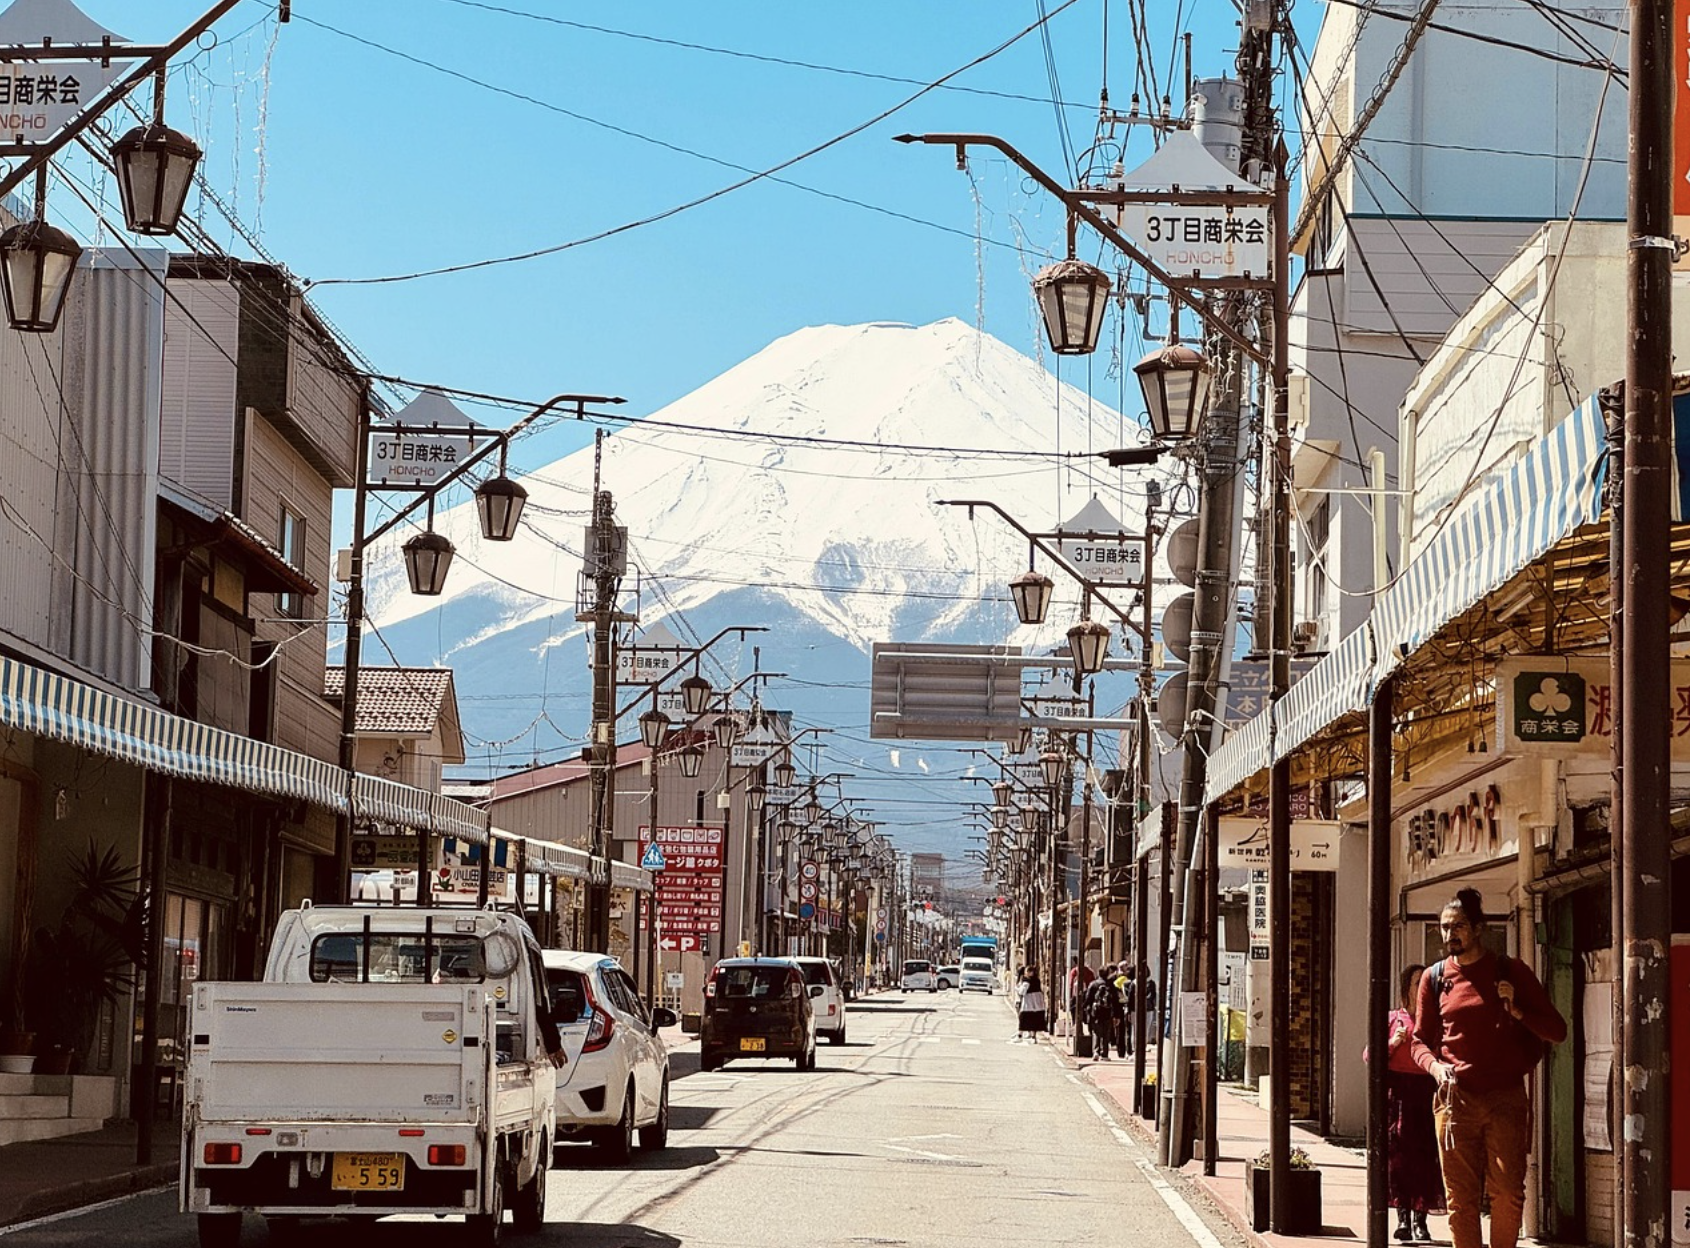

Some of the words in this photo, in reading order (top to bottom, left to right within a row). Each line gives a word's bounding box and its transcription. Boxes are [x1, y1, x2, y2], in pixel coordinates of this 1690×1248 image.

[1147, 217, 1264, 244] 3丁目商栄会
[377, 442, 456, 462] 3丁目商栄会
[1074, 547, 1140, 563] 3丁目商栄会
[621, 656, 669, 669] 3丁目商栄会
[1520, 719, 1580, 734] 商栄会
[681, 937, 695, 951] P
